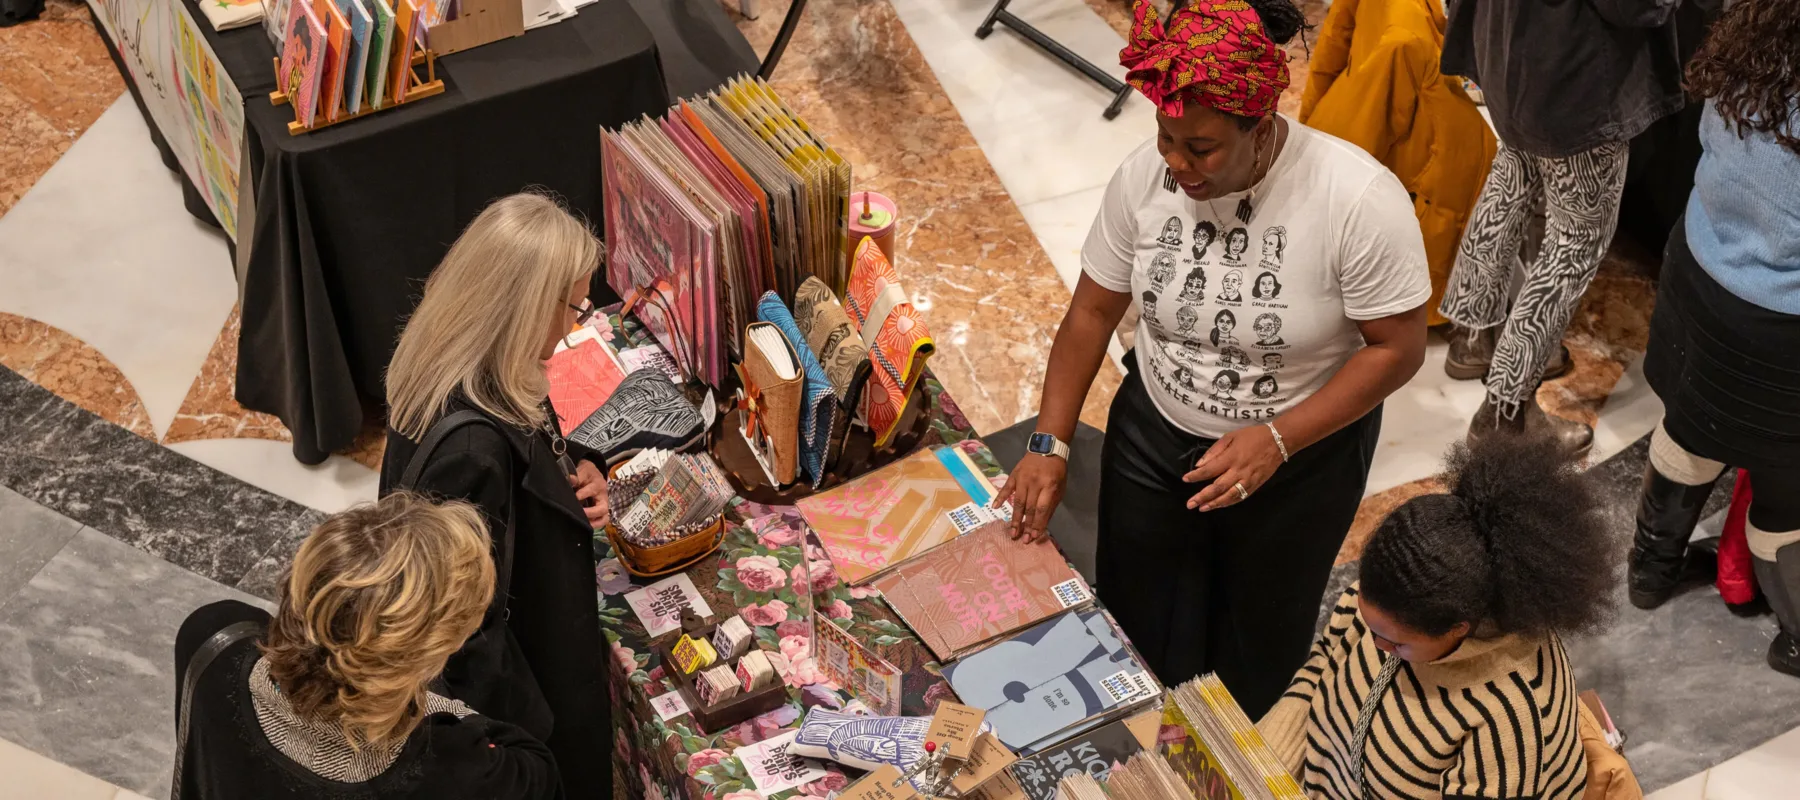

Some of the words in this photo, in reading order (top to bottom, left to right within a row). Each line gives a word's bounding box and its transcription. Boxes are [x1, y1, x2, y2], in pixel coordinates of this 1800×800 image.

[1198, 401, 1275, 419] ARTISTS
[949, 511, 967, 532] SERIES
[821, 495, 855, 520] MY
[844, 525, 887, 571] FACE
[873, 523, 901, 545] OF
[1054, 585, 1071, 606] SERIES
[650, 601, 667, 617] $10
[936, 583, 983, 632] MUTE
[974, 591, 1008, 622] ON
[1101, 680, 1121, 701] SERIES
[1108, 676, 1128, 695] SALTY
[1061, 698, 1070, 706] so
[761, 758, 780, 776] $10
